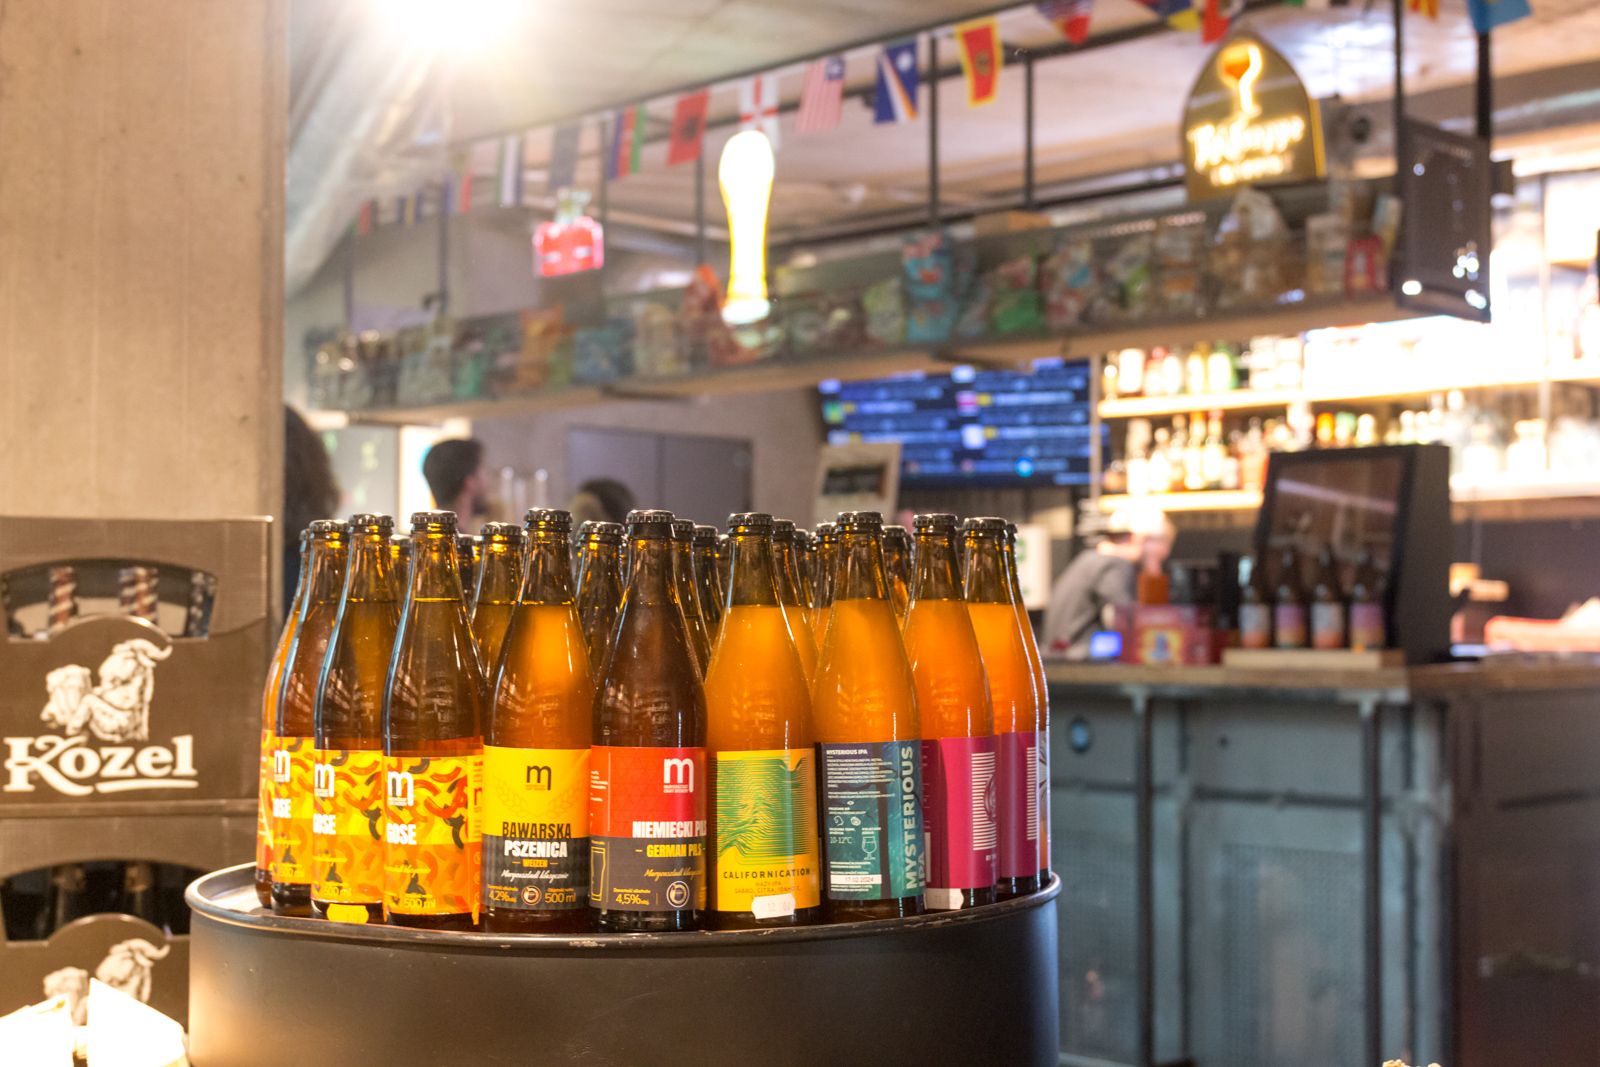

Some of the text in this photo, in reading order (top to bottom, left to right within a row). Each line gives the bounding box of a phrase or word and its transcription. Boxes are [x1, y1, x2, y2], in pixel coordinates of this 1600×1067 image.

[4, 735, 198, 796] Kozel
[273, 798, 292, 818] OSE
[901, 746, 917, 889] MYSTERIOUS
[502, 822, 571, 839] BAWARSKA
[632, 821, 693, 838] NIEMIECKI
[504, 840, 568, 858] PSZENICA
[646, 844, 687, 858] GERMAN
[723, 868, 811, 879] CALIFORNICATION
[545, 893, 564, 904] 500
